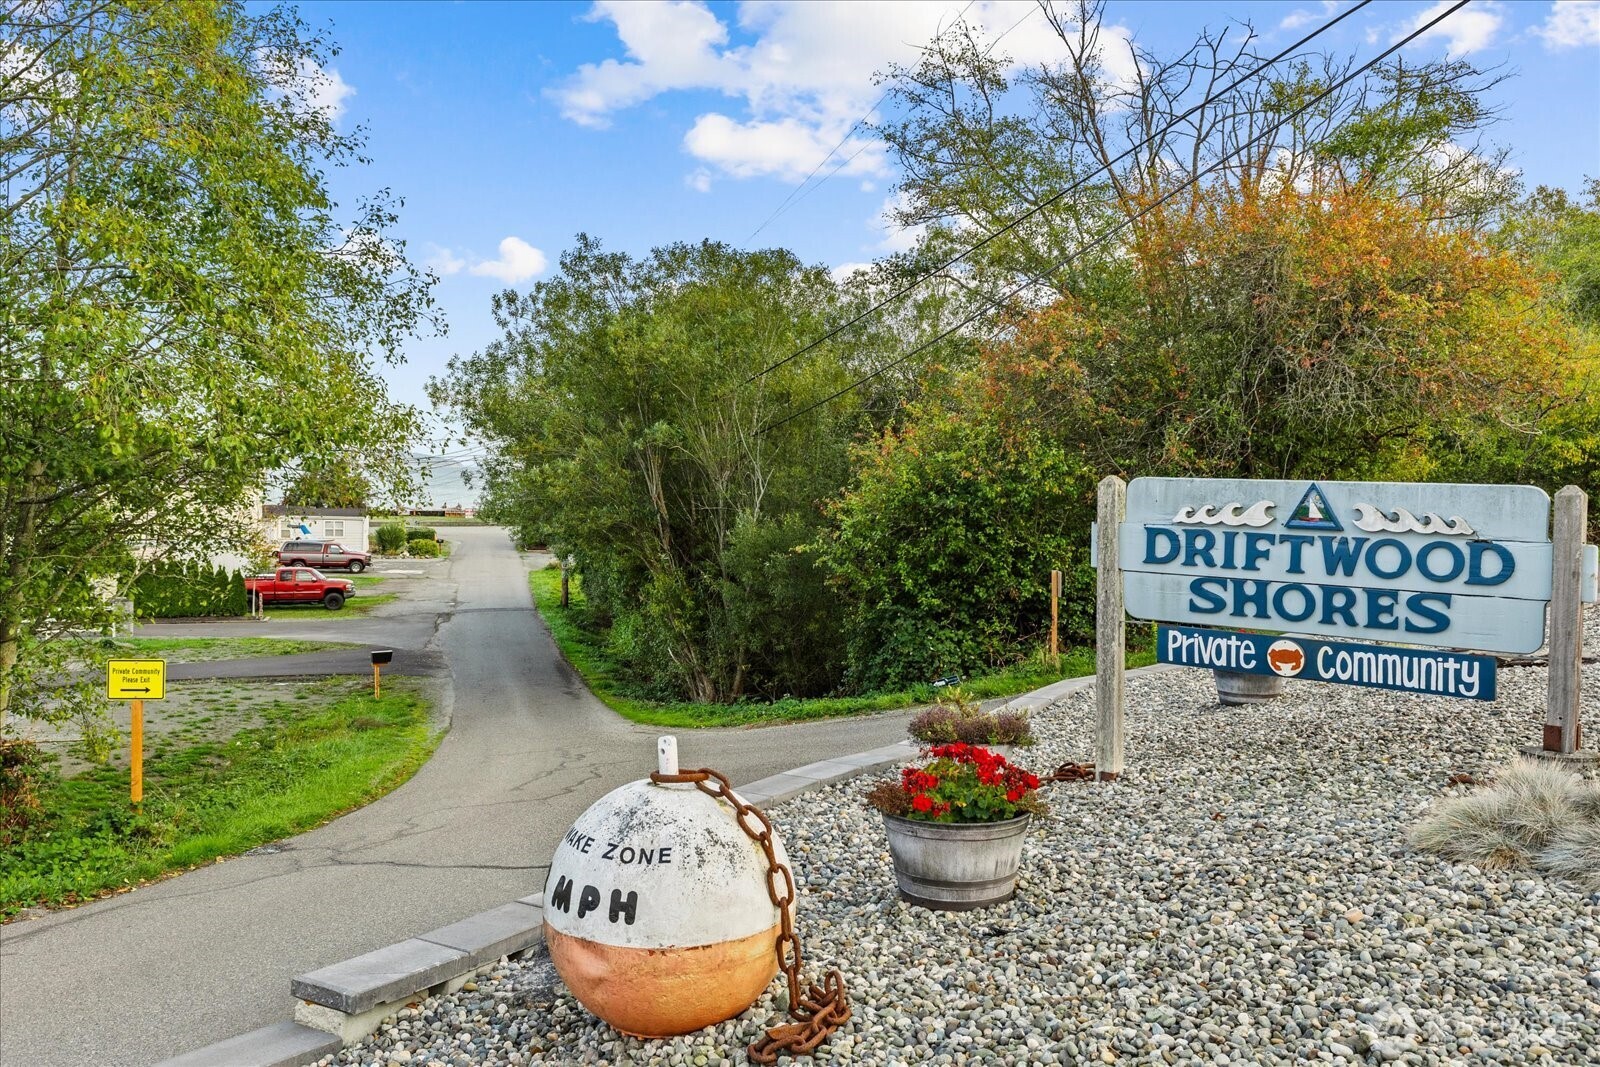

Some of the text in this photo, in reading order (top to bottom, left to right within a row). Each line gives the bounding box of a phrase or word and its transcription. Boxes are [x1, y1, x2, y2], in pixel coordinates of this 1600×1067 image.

[1142, 524, 1516, 586] DRIFTWOOD
[1188, 576, 1452, 634] SHORES
[132, 668, 160, 676] Community
[1167, 629, 1481, 697] Private Community
[602, 842, 672, 865] ZONE
[551, 875, 638, 926] MPH
